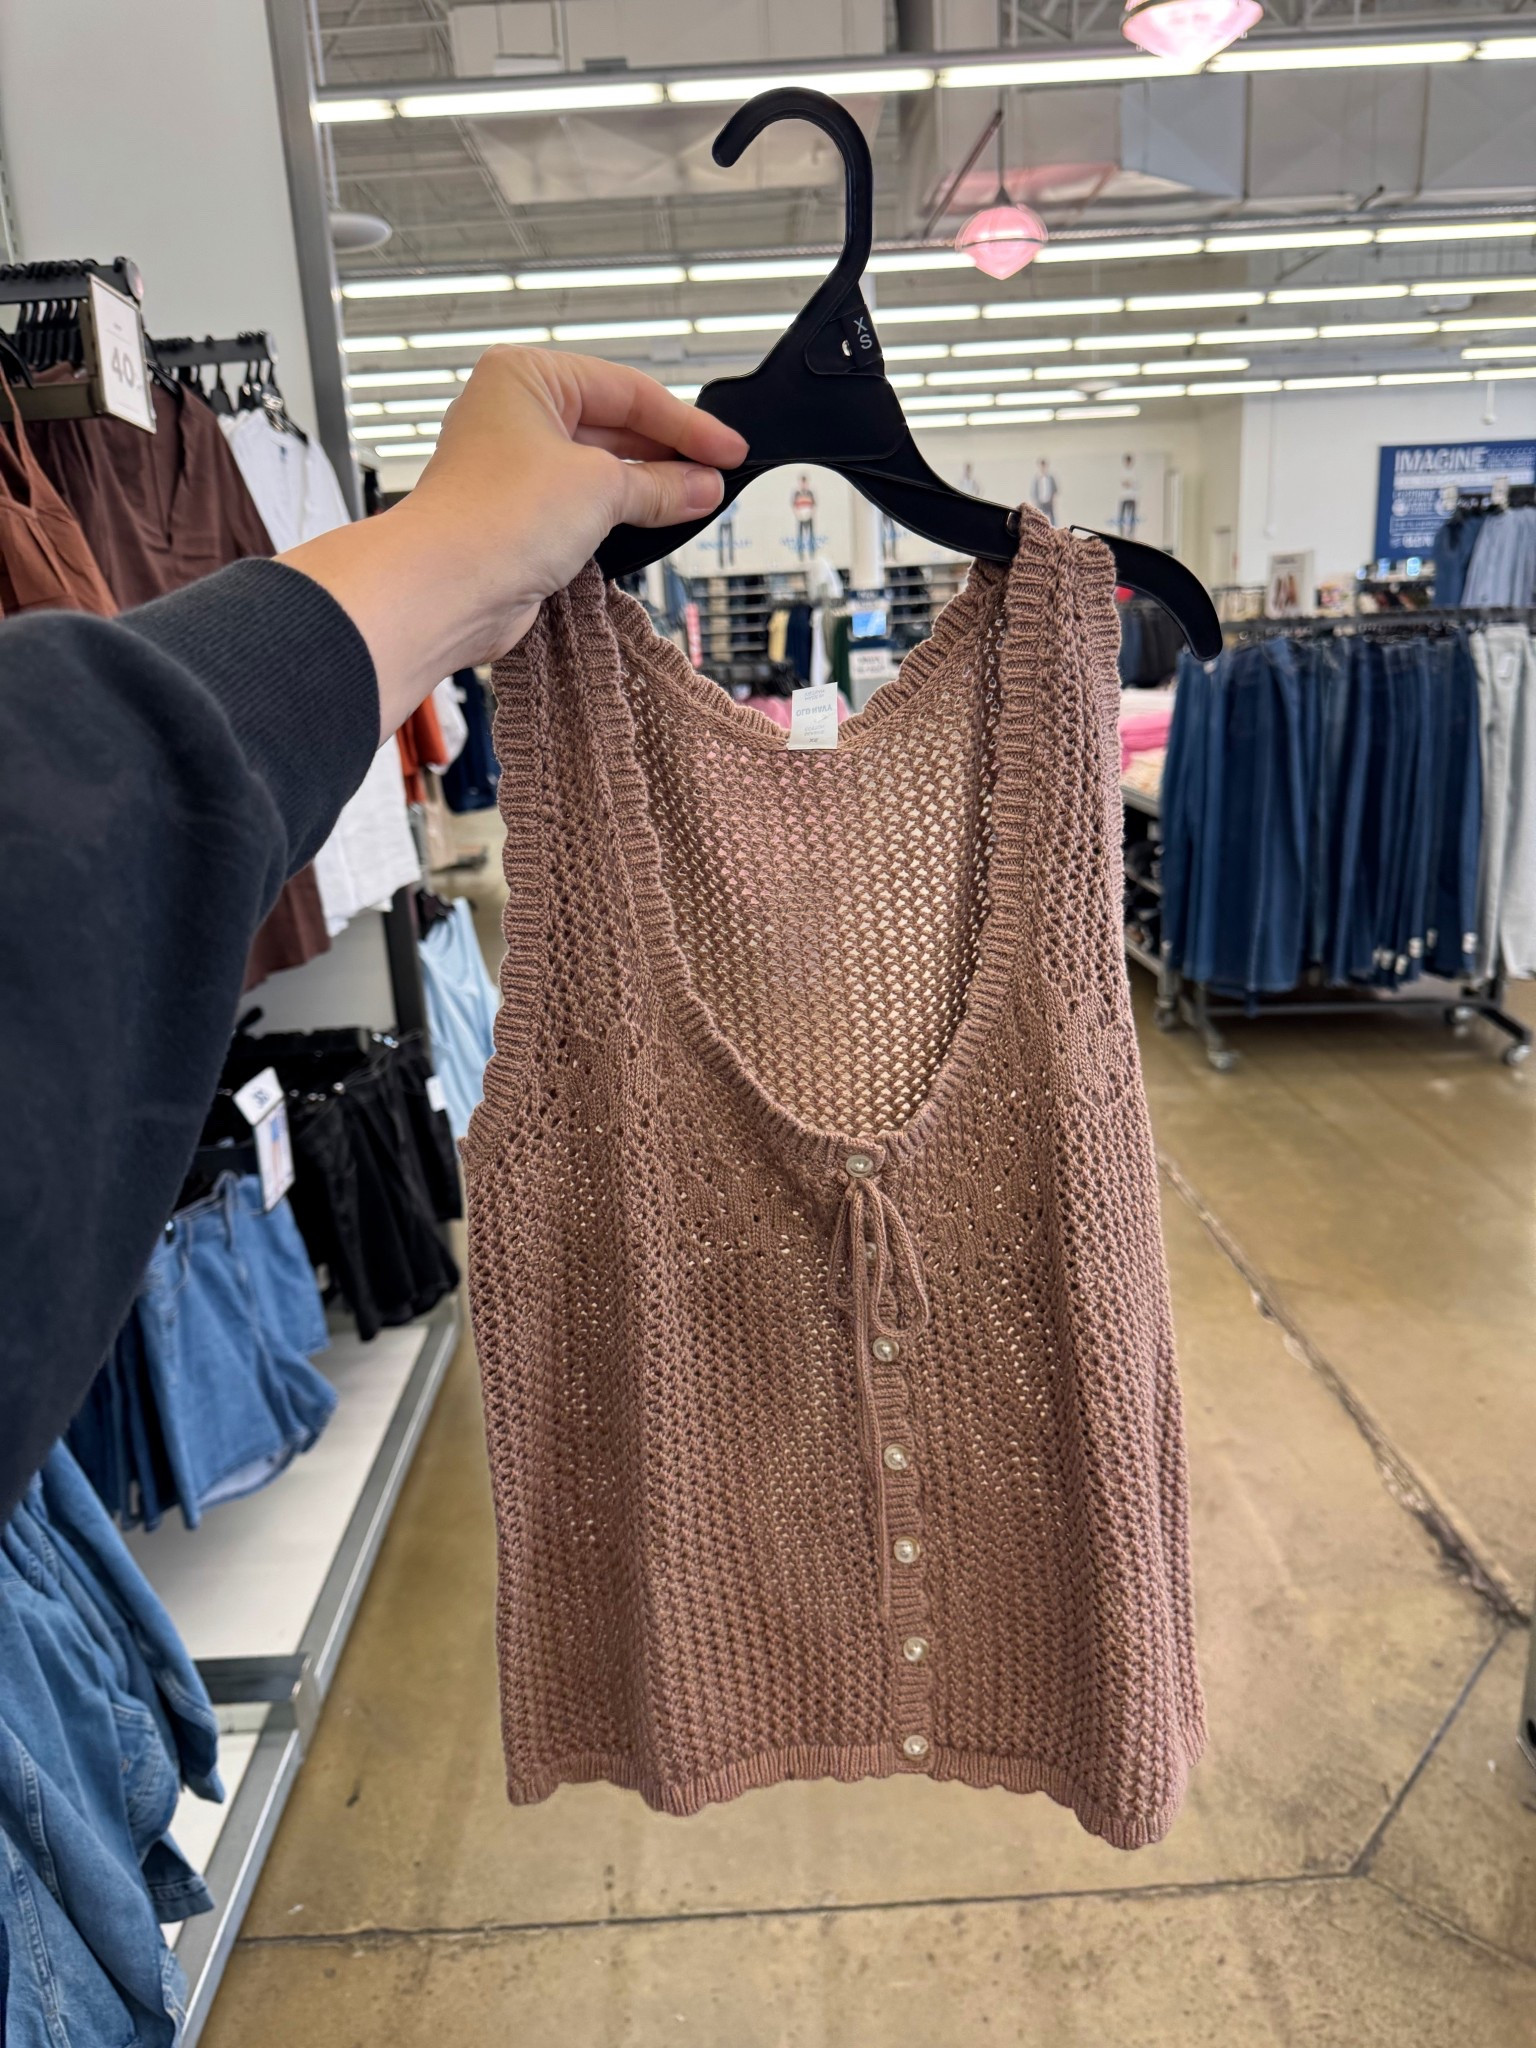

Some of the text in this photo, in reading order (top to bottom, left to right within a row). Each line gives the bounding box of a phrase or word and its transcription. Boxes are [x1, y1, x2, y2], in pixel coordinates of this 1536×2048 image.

[853, 316, 873, 350] XS
[111, 346, 134, 388] 40
[1394, 447, 1487, 473] IMAGINE
